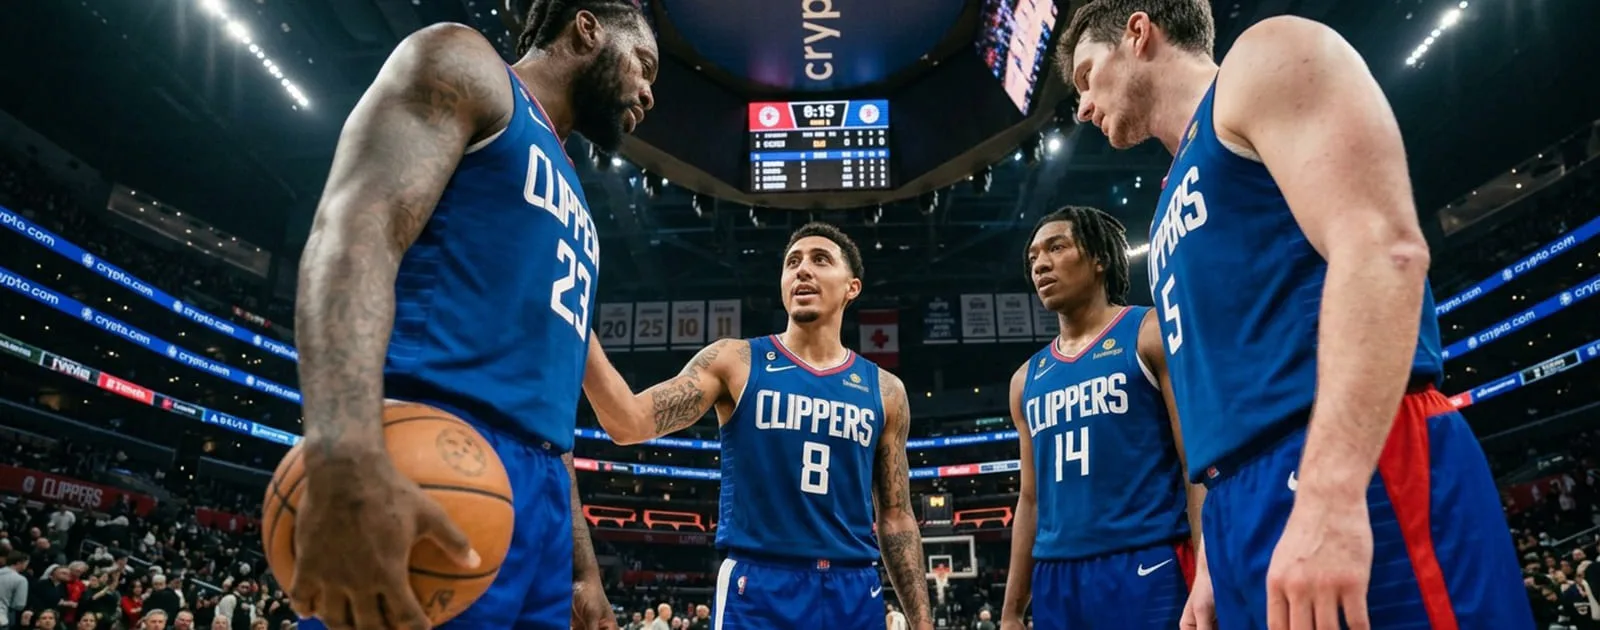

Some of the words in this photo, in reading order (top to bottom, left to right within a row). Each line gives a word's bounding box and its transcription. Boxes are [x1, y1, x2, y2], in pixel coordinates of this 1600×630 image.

[803, 0, 841, 81] cryp
[551, 238, 591, 342] 23
[1161, 273, 1183, 355] 5
[602, 321, 627, 338] 20
[639, 319, 663, 337] 25
[678, 318, 698, 337] 10
[717, 317, 732, 336] 11
[755, 389, 875, 448] CLIPPERS
[1026, 372, 1129, 438] CLIPPERS
[800, 441, 830, 495] 8
[1055, 426, 1089, 482] 14
